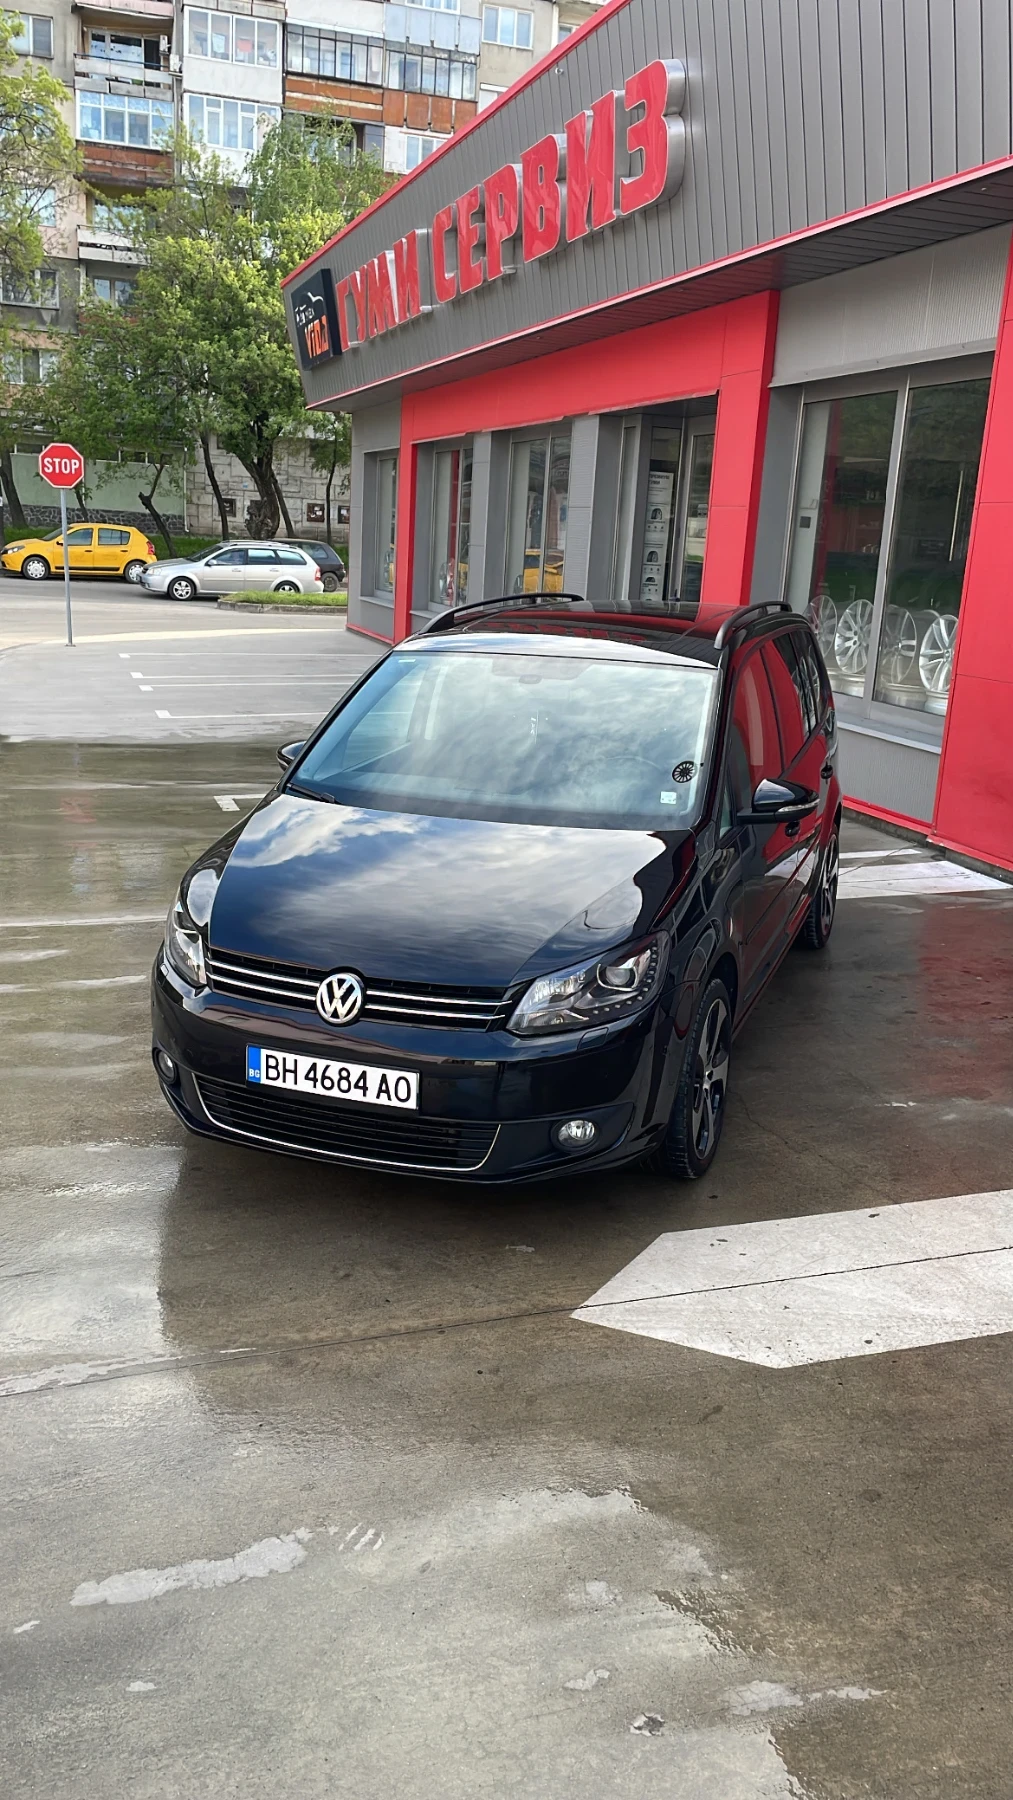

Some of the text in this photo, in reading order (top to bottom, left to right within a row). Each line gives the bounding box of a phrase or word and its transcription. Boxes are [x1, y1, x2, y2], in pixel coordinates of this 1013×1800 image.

[335, 58, 676, 353] ГУМИ СЕРВИЗ
[43, 457, 80, 475] STOP
[316, 973, 363, 1024] VW
[249, 1068, 261, 1078] BG
[265, 1054, 298, 1086] BH
[304, 1062, 369, 1097] 4684
